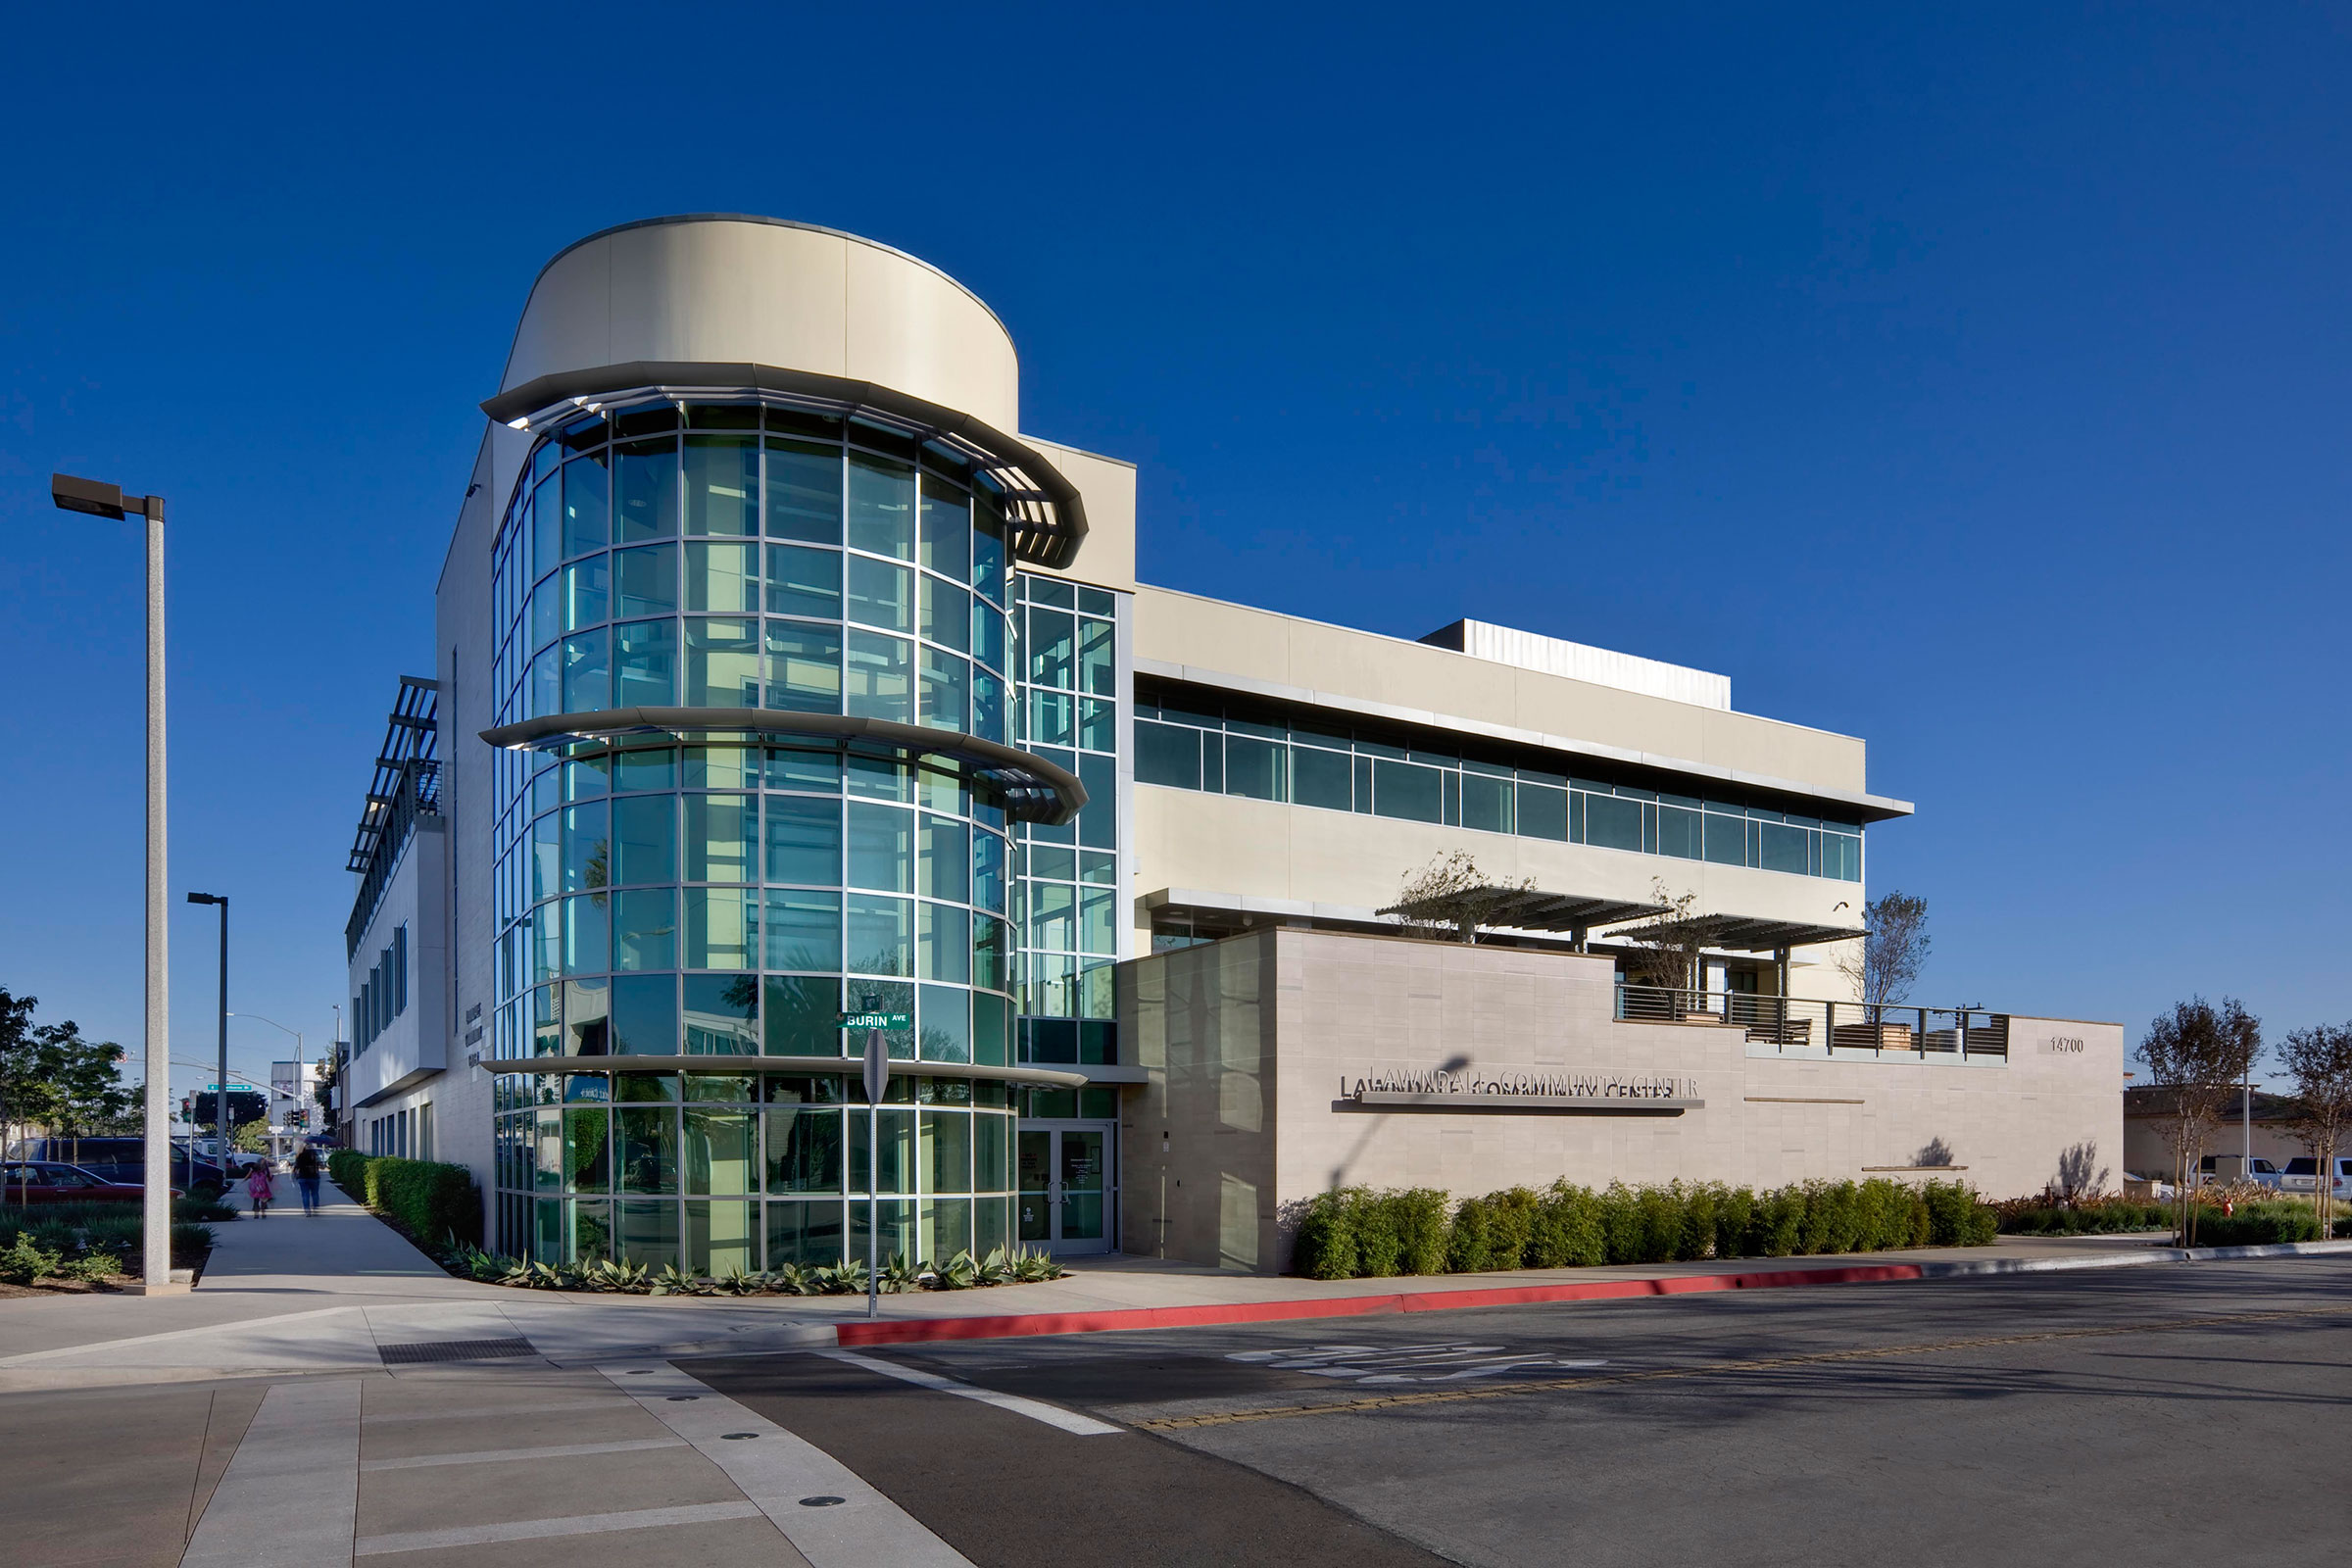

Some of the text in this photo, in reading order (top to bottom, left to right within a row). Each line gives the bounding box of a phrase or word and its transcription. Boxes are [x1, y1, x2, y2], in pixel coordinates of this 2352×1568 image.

[846, 1015, 888, 1027] BURIN
[2050, 1036, 2083, 1053] 14700
[1370, 1066, 1699, 1100] LAWNDALE COMMUNITY CENTER
